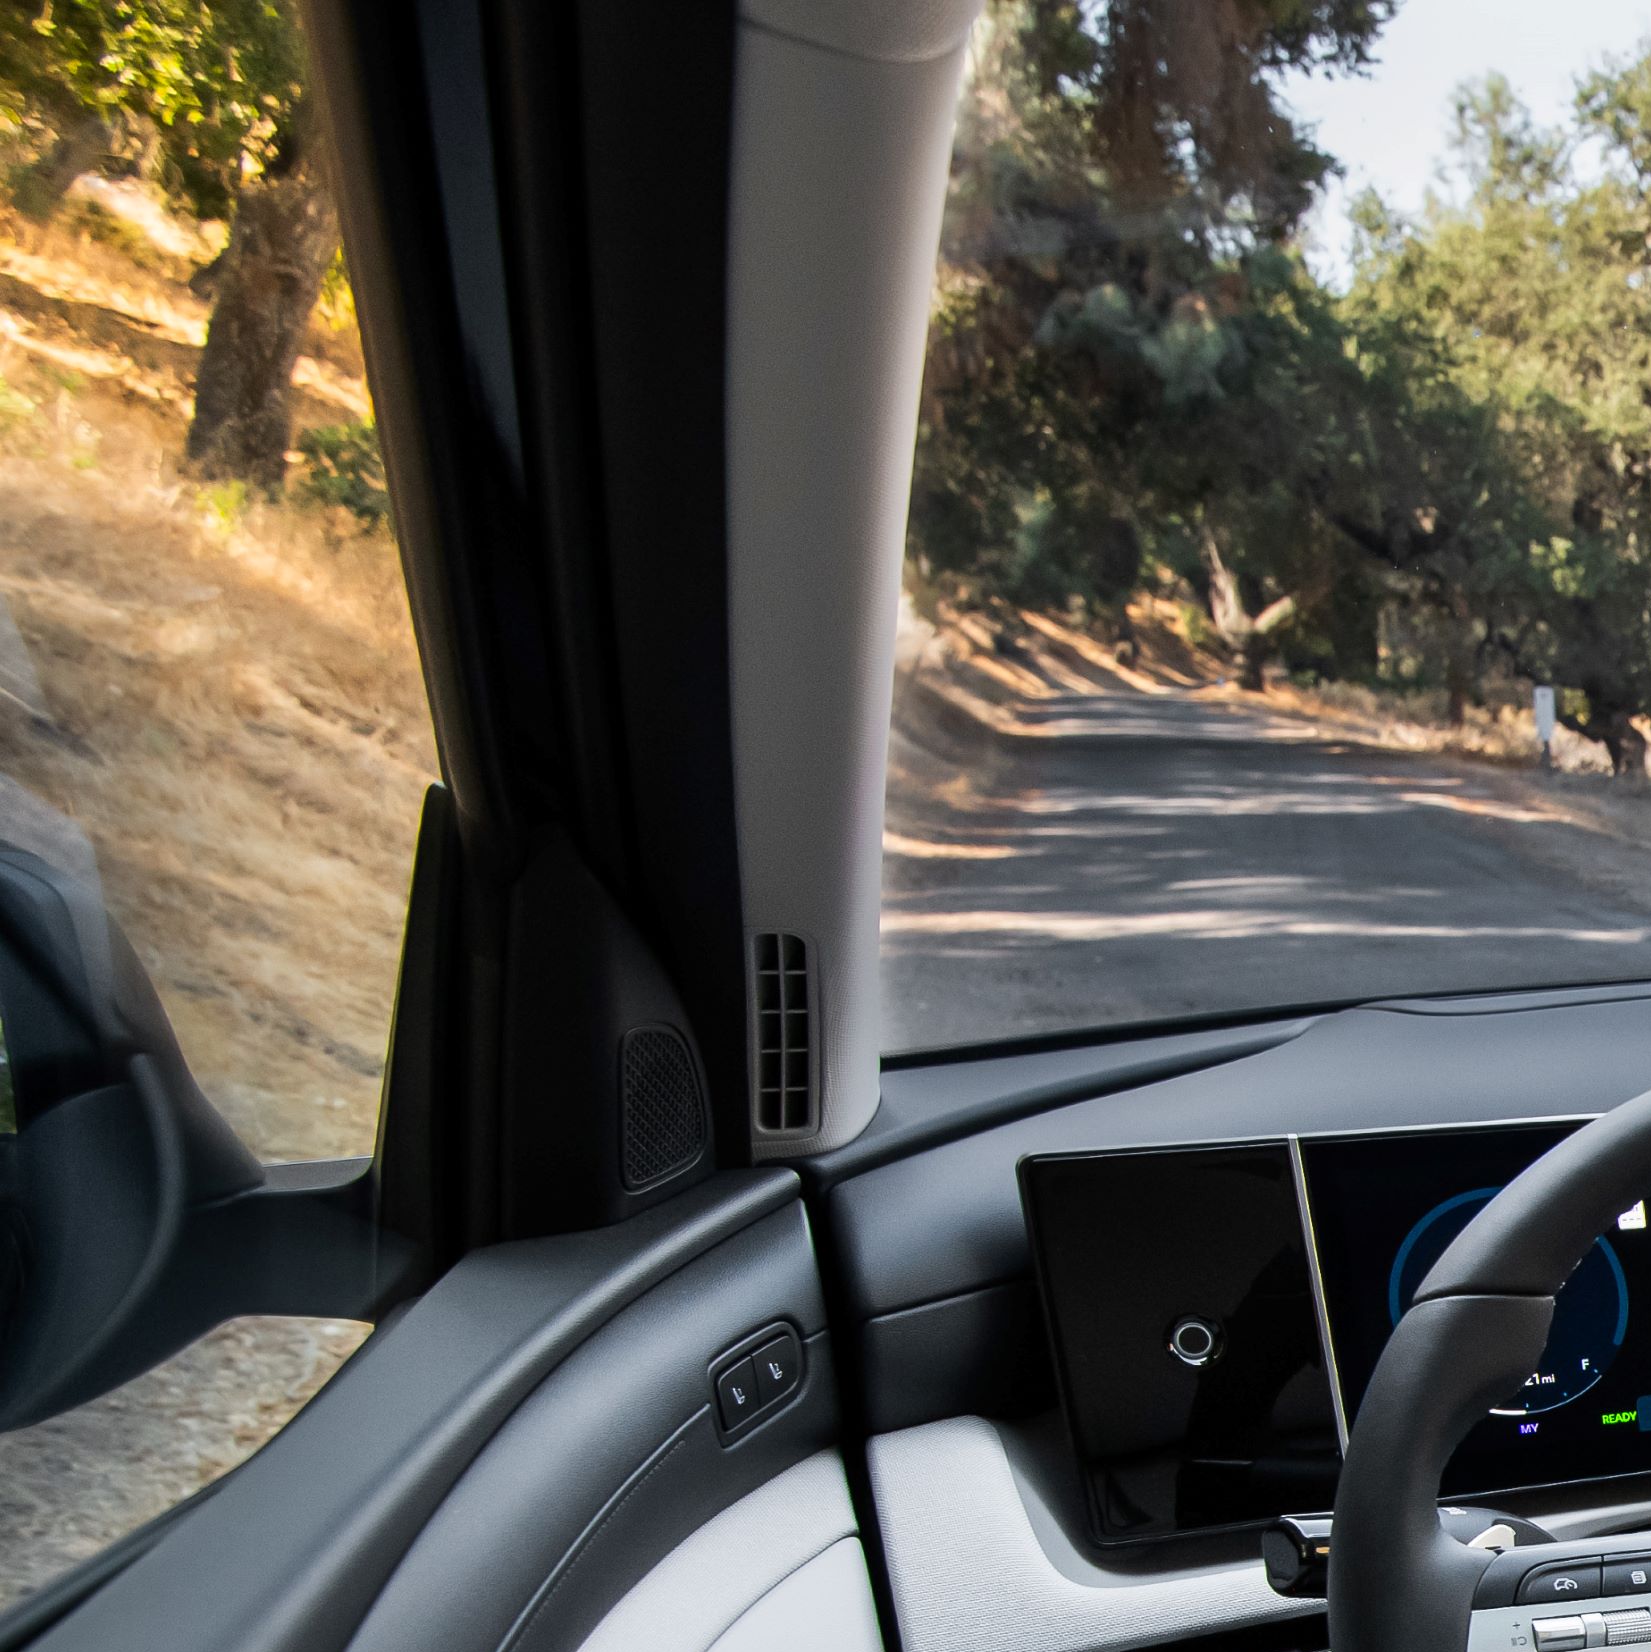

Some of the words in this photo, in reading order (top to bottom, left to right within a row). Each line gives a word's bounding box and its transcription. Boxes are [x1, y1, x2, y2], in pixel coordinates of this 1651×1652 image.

[1581, 1358, 1590, 1371] F
[1602, 1411, 1637, 1425] READY
[1520, 1423, 1539, 1434] MY
